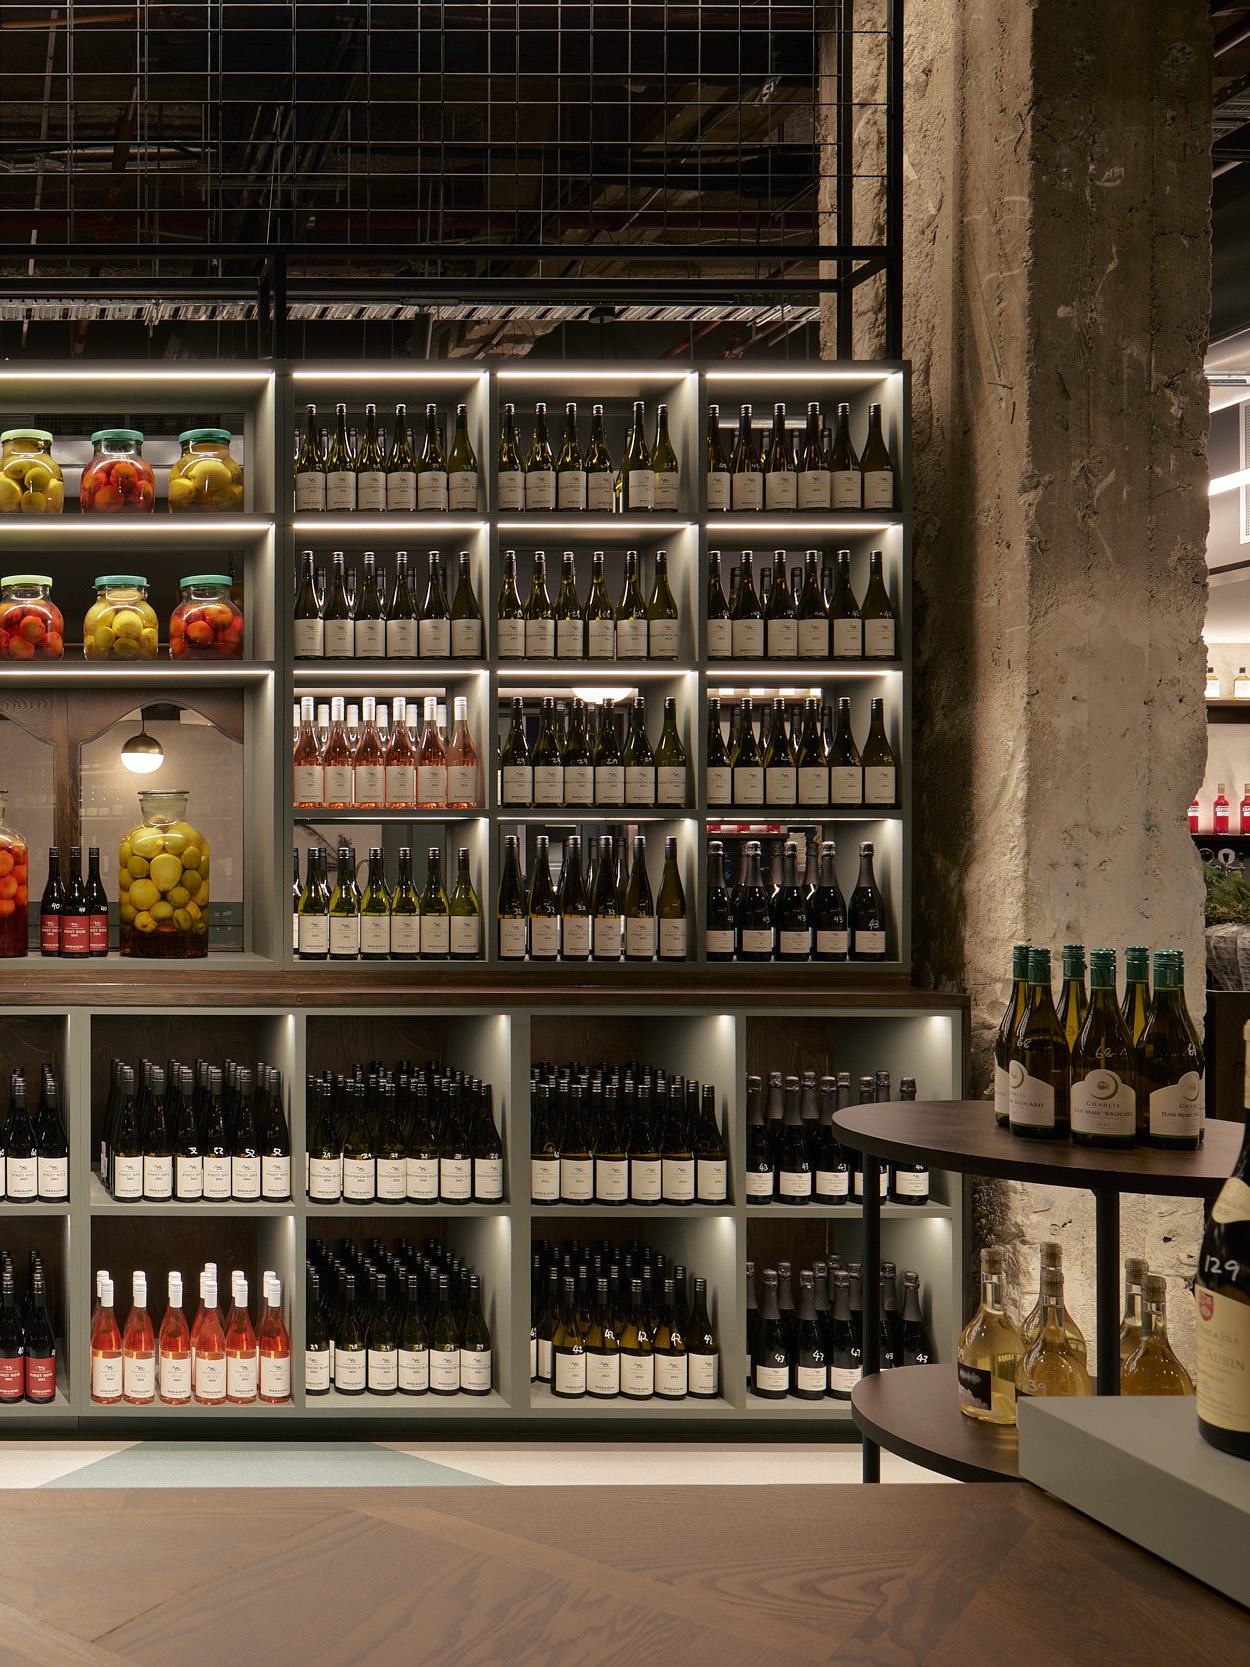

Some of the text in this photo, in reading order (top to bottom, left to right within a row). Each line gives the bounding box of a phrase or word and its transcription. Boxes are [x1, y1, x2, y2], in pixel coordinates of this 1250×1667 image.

[1017, 1038, 1032, 1049] 68
[1096, 1046, 1113, 1058] 68
[1205, 1255, 1240, 1281] 129
[1206, 1347, 1245, 1370] AUBIN
[1028, 1379, 1047, 1396] 39
